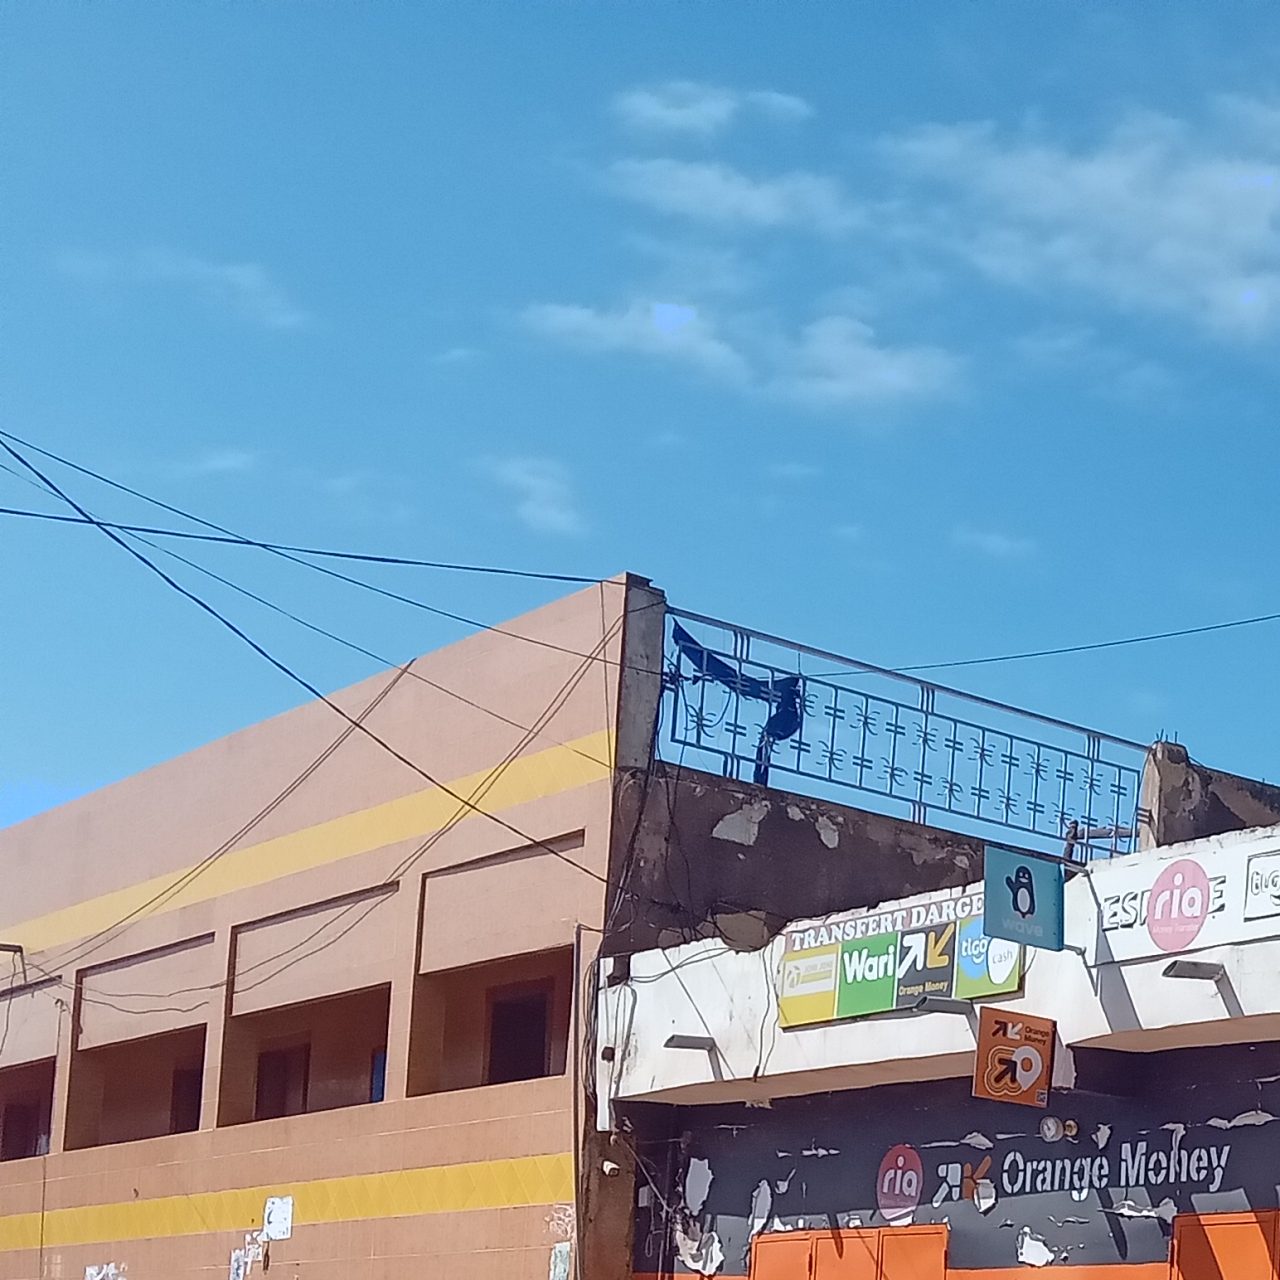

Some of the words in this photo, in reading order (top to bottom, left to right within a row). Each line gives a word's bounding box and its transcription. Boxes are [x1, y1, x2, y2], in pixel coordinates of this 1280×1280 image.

[1154, 872, 1202, 920] ria
[791, 910, 907, 951] TRANSFERT
[961, 937, 988, 957] tigo
[1002, 918, 1044, 937] wave
[843, 945, 895, 984] Wari
[992, 949, 1014, 964] cash
[898, 984, 924, 996] Orange
[924, 981, 949, 992] Money
[883, 1155, 918, 1197] ria
[1001, 1150, 1110, 1202] Orange
[1119, 1142, 1231, 1193] Money
